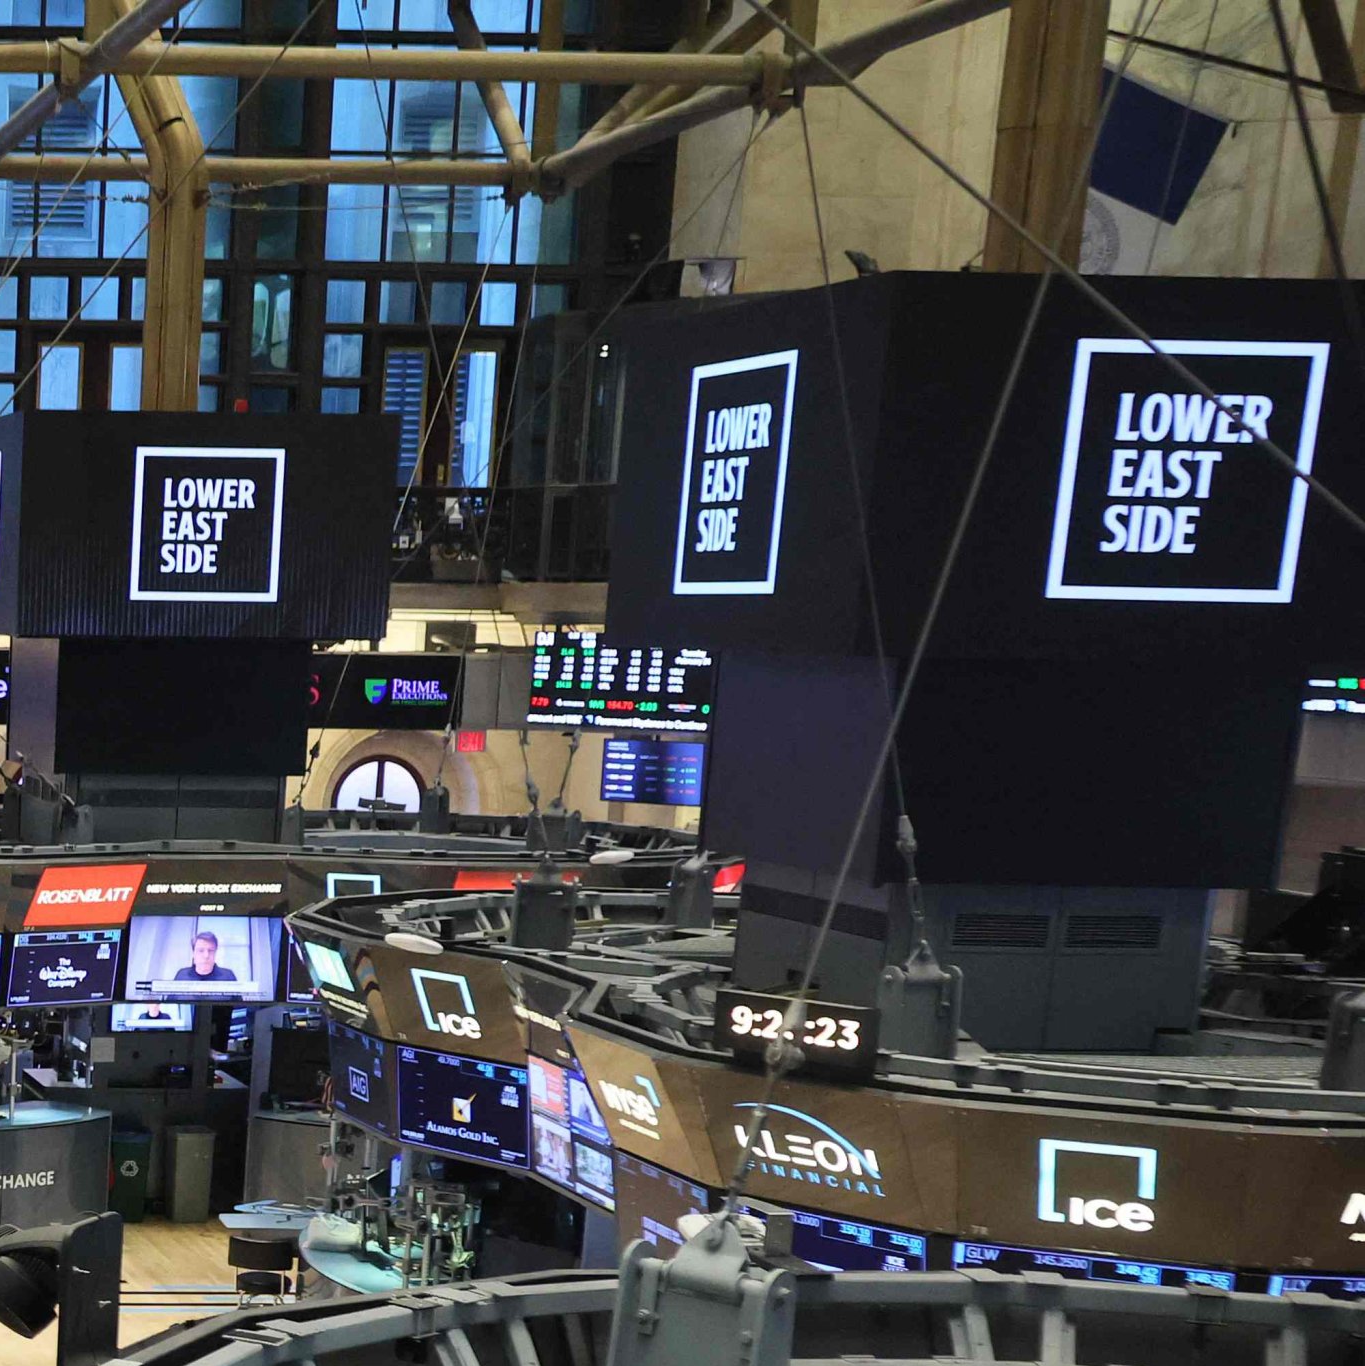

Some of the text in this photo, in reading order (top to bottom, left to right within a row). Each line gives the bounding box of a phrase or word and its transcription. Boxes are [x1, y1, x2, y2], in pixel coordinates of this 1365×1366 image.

[705, 402, 772, 455] LOWER
[1114, 392, 1274, 445] LOWER
[701, 456, 749, 502] EAST
[1107, 448, 1223, 499] EAST
[163, 477, 256, 509] LOWER
[162, 511, 228, 541] EAST
[695, 507, 739, 553] SIDE
[1099, 504, 1201, 555] SIDE
[160, 544, 218, 574] SIDE
[37, 886, 133, 905] ROSENBLATT
[146, 883, 282, 894] NEW YORK STOCK EXCHANGE
[731, 1005, 861, 1050] 9:2:23
[351, 1075, 367, 1095] AIG
[427, 1121, 499, 1145] ALAMOS GOLD INC.
[966, 1246, 999, 1261] GLW
